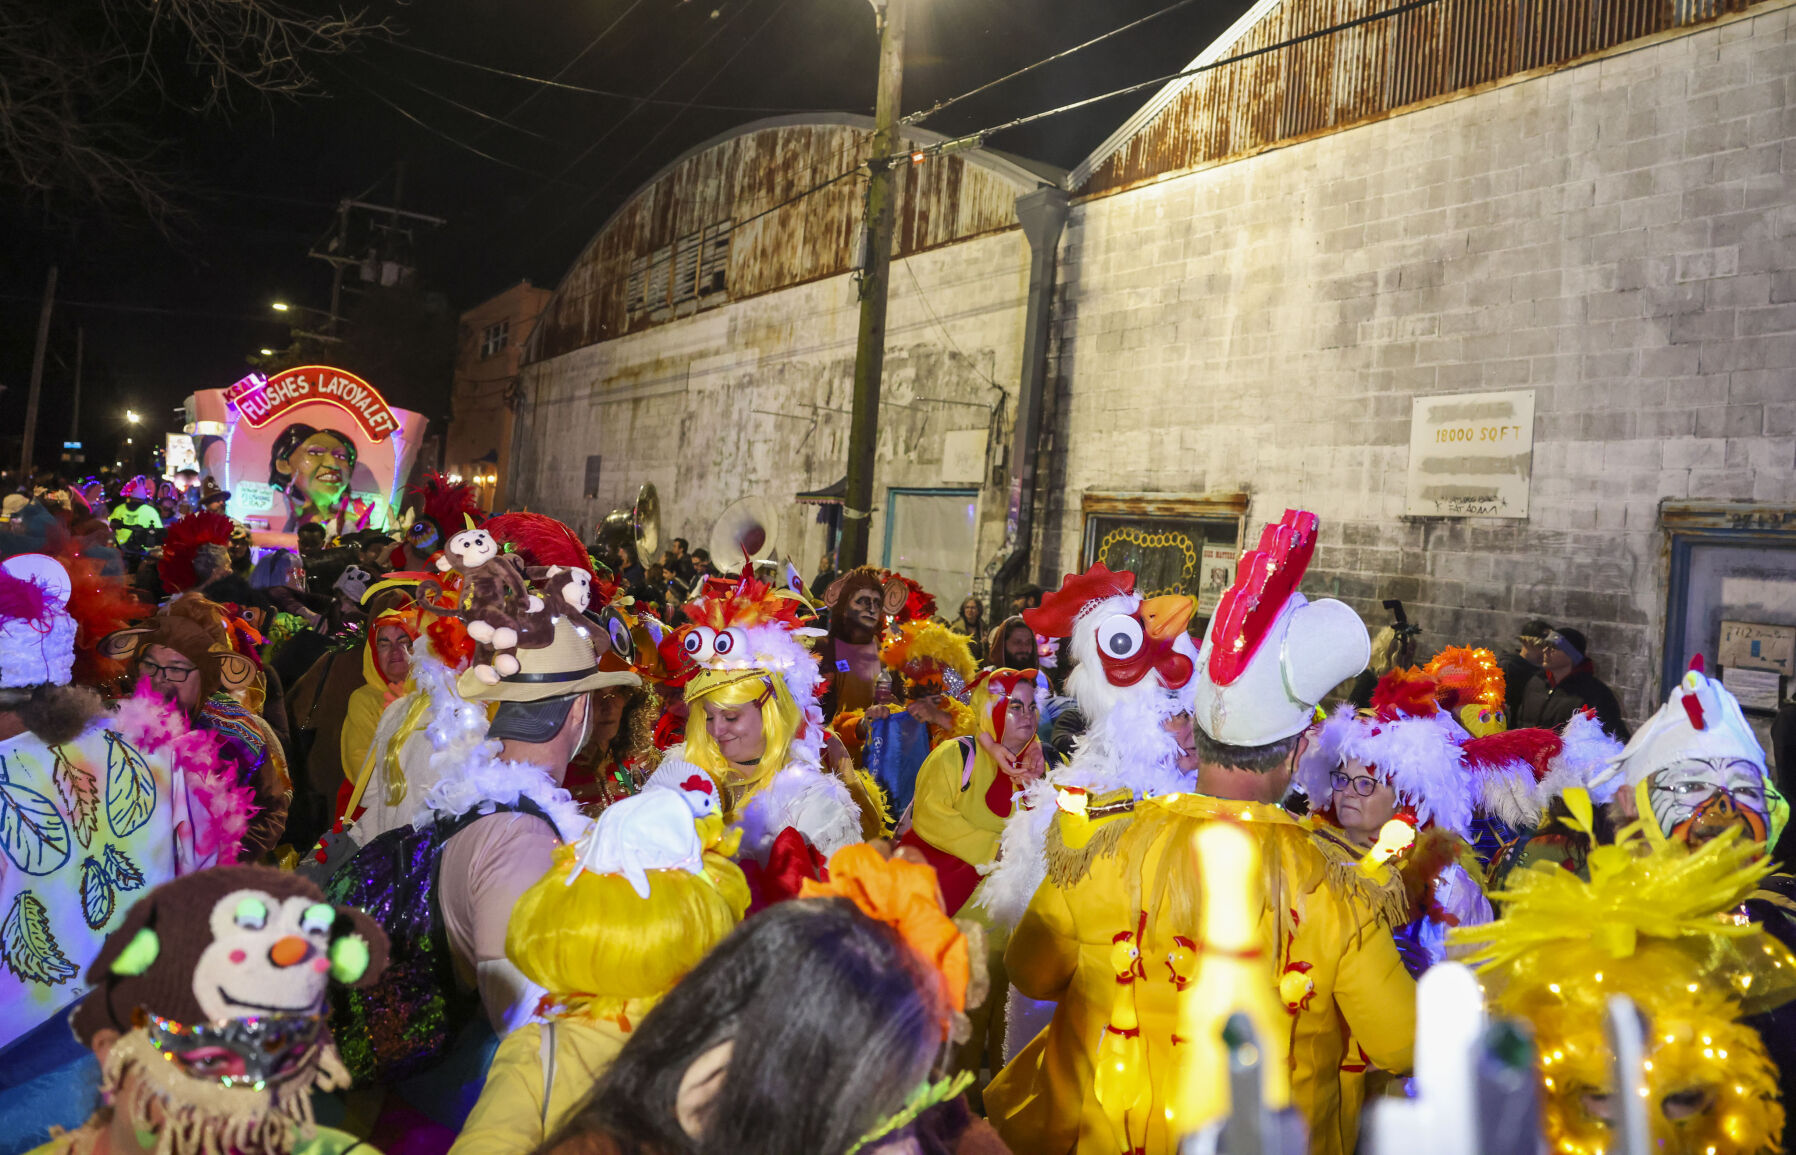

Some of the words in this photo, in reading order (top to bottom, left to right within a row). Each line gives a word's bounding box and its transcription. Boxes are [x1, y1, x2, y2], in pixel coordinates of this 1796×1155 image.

[241, 375, 310, 420] FLUSHES
[318, 373, 393, 434] LATOYALET
[1436, 428, 1473, 443] 18000
[1480, 426, 1521, 442] SQFT
